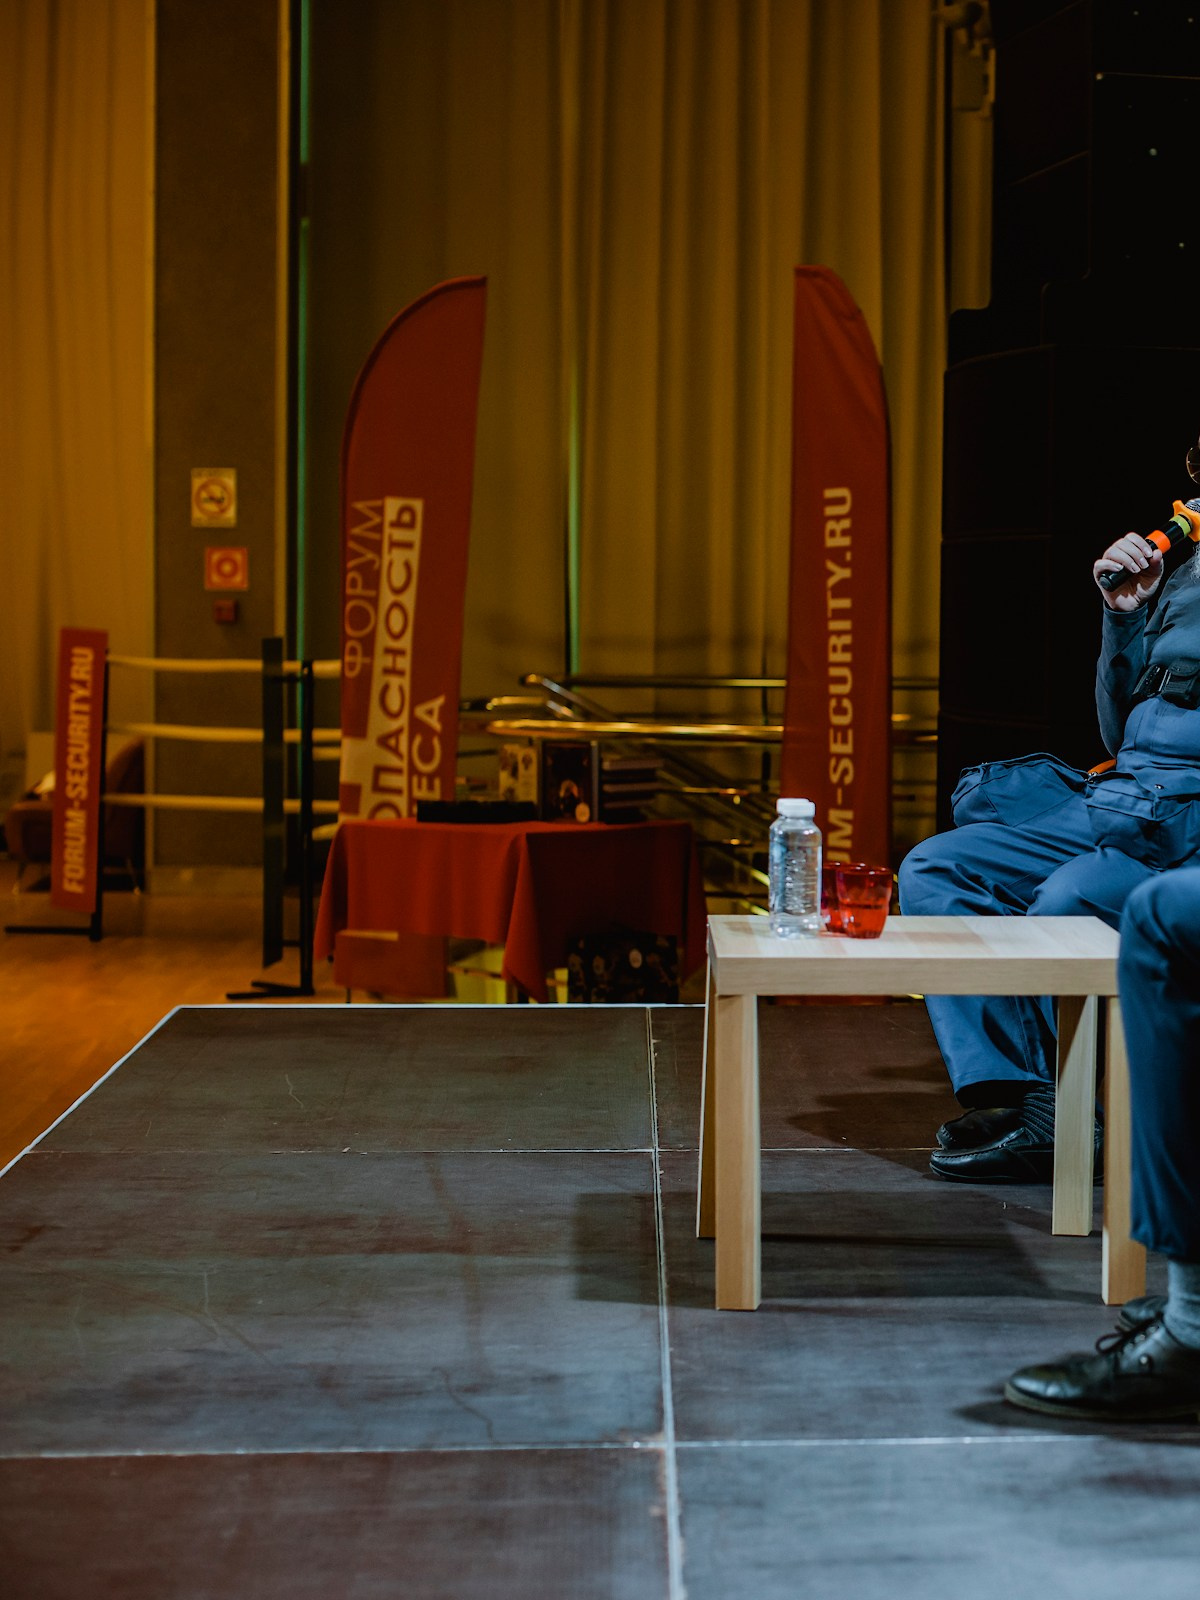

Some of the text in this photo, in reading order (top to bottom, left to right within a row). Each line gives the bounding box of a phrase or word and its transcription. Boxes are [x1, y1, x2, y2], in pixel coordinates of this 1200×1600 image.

[344, 500, 383, 679] ФОРУМ
[62, 647, 95, 894] FORUM-SECURITY.RU
[411, 695, 446, 817] ЕСА
